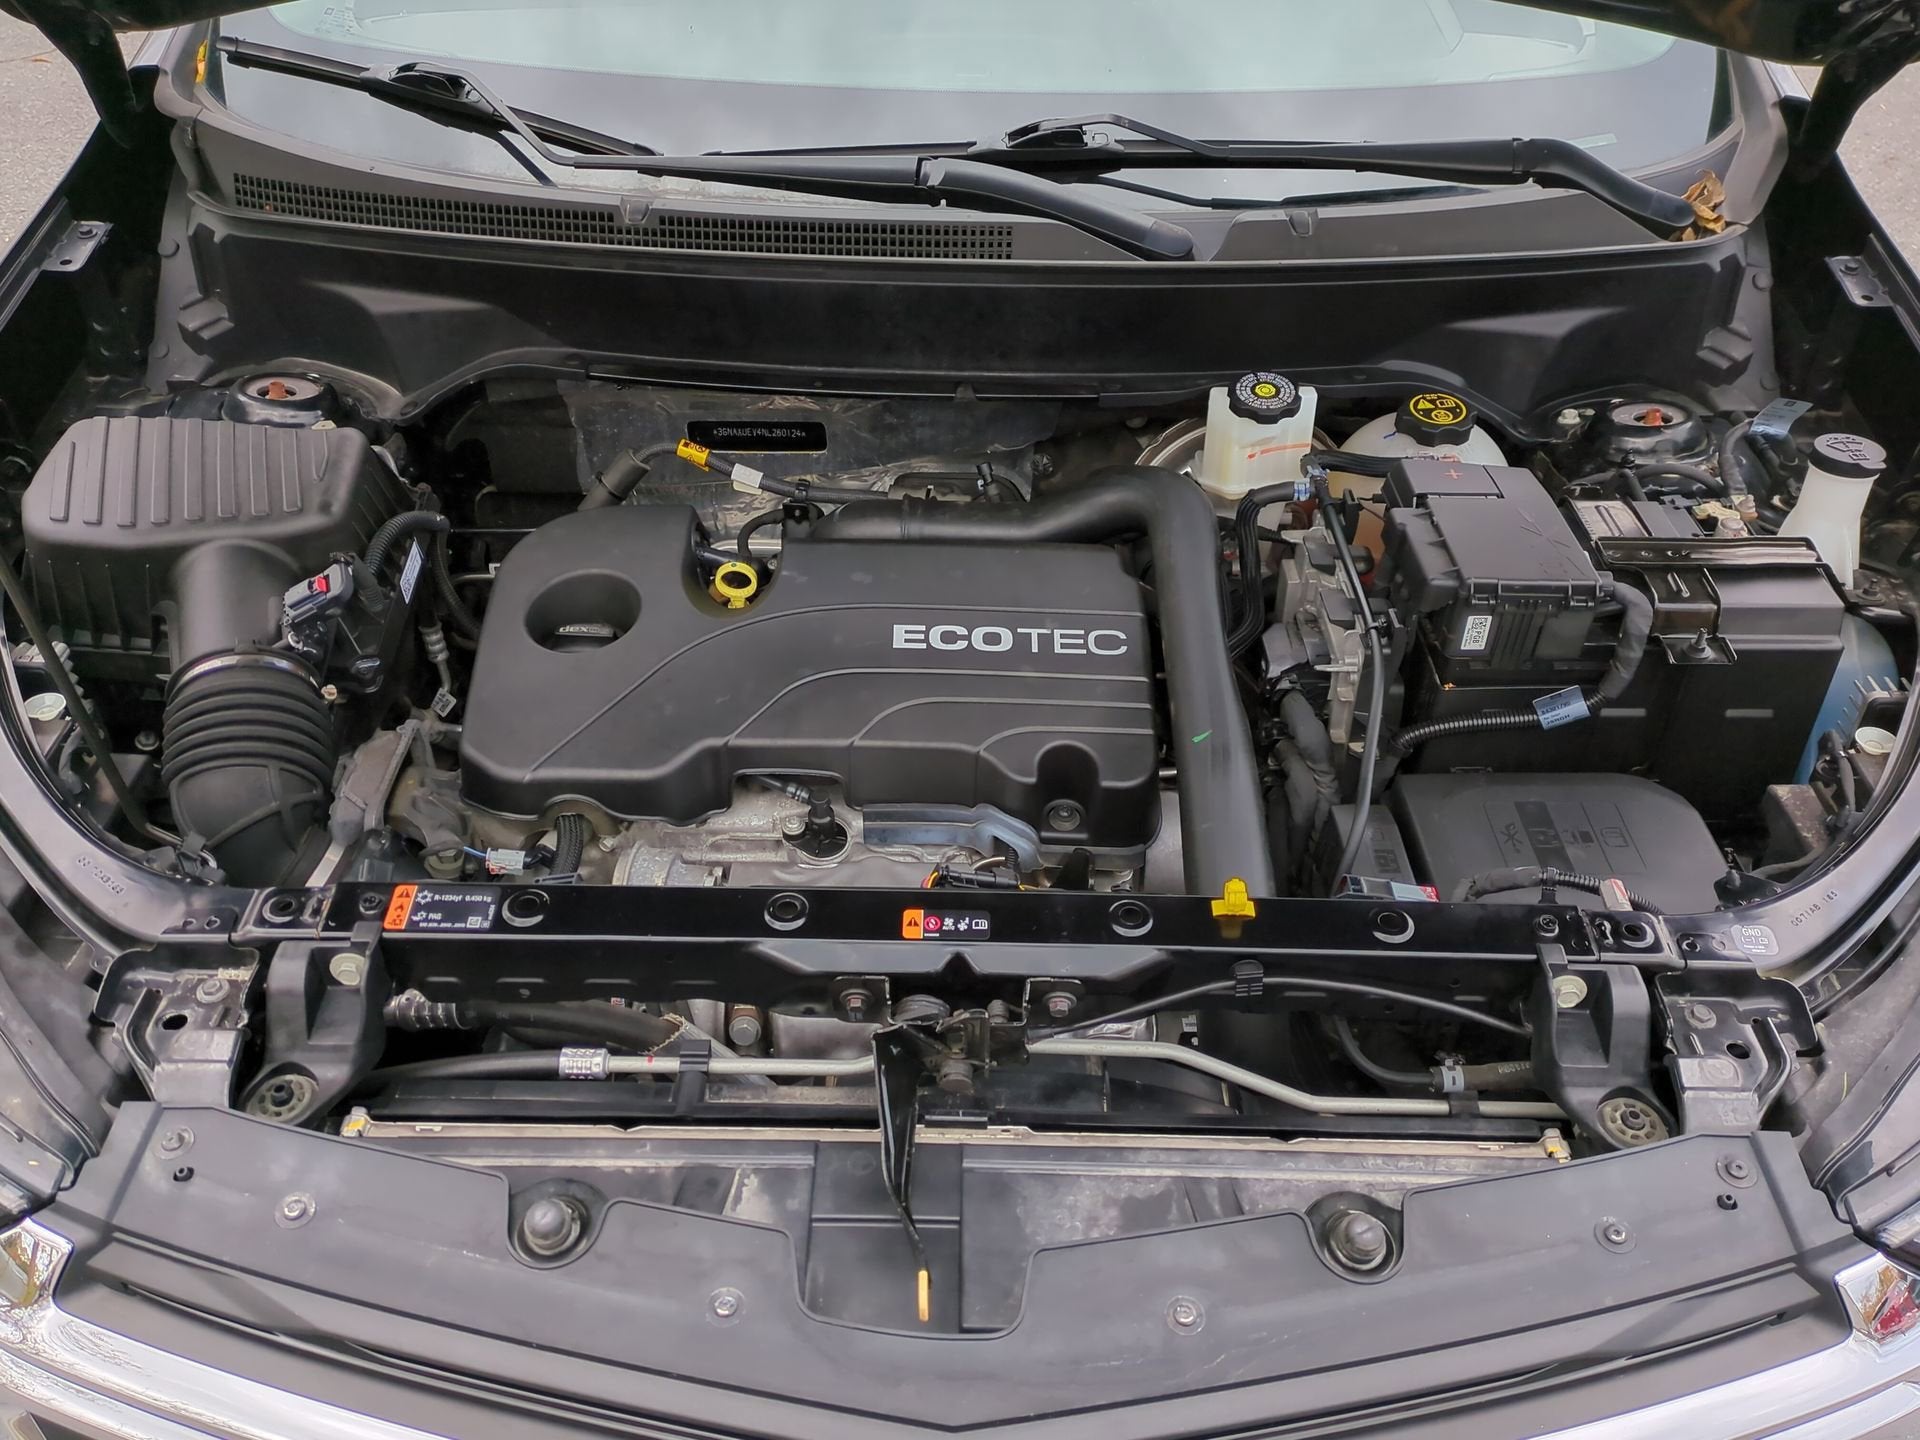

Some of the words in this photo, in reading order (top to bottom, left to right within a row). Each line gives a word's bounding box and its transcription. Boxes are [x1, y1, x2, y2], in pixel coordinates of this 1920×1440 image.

[892, 624, 1128, 655] ECOTEC
[1472, 630, 1482, 644] PGB
[1742, 928, 1761, 937] GND
